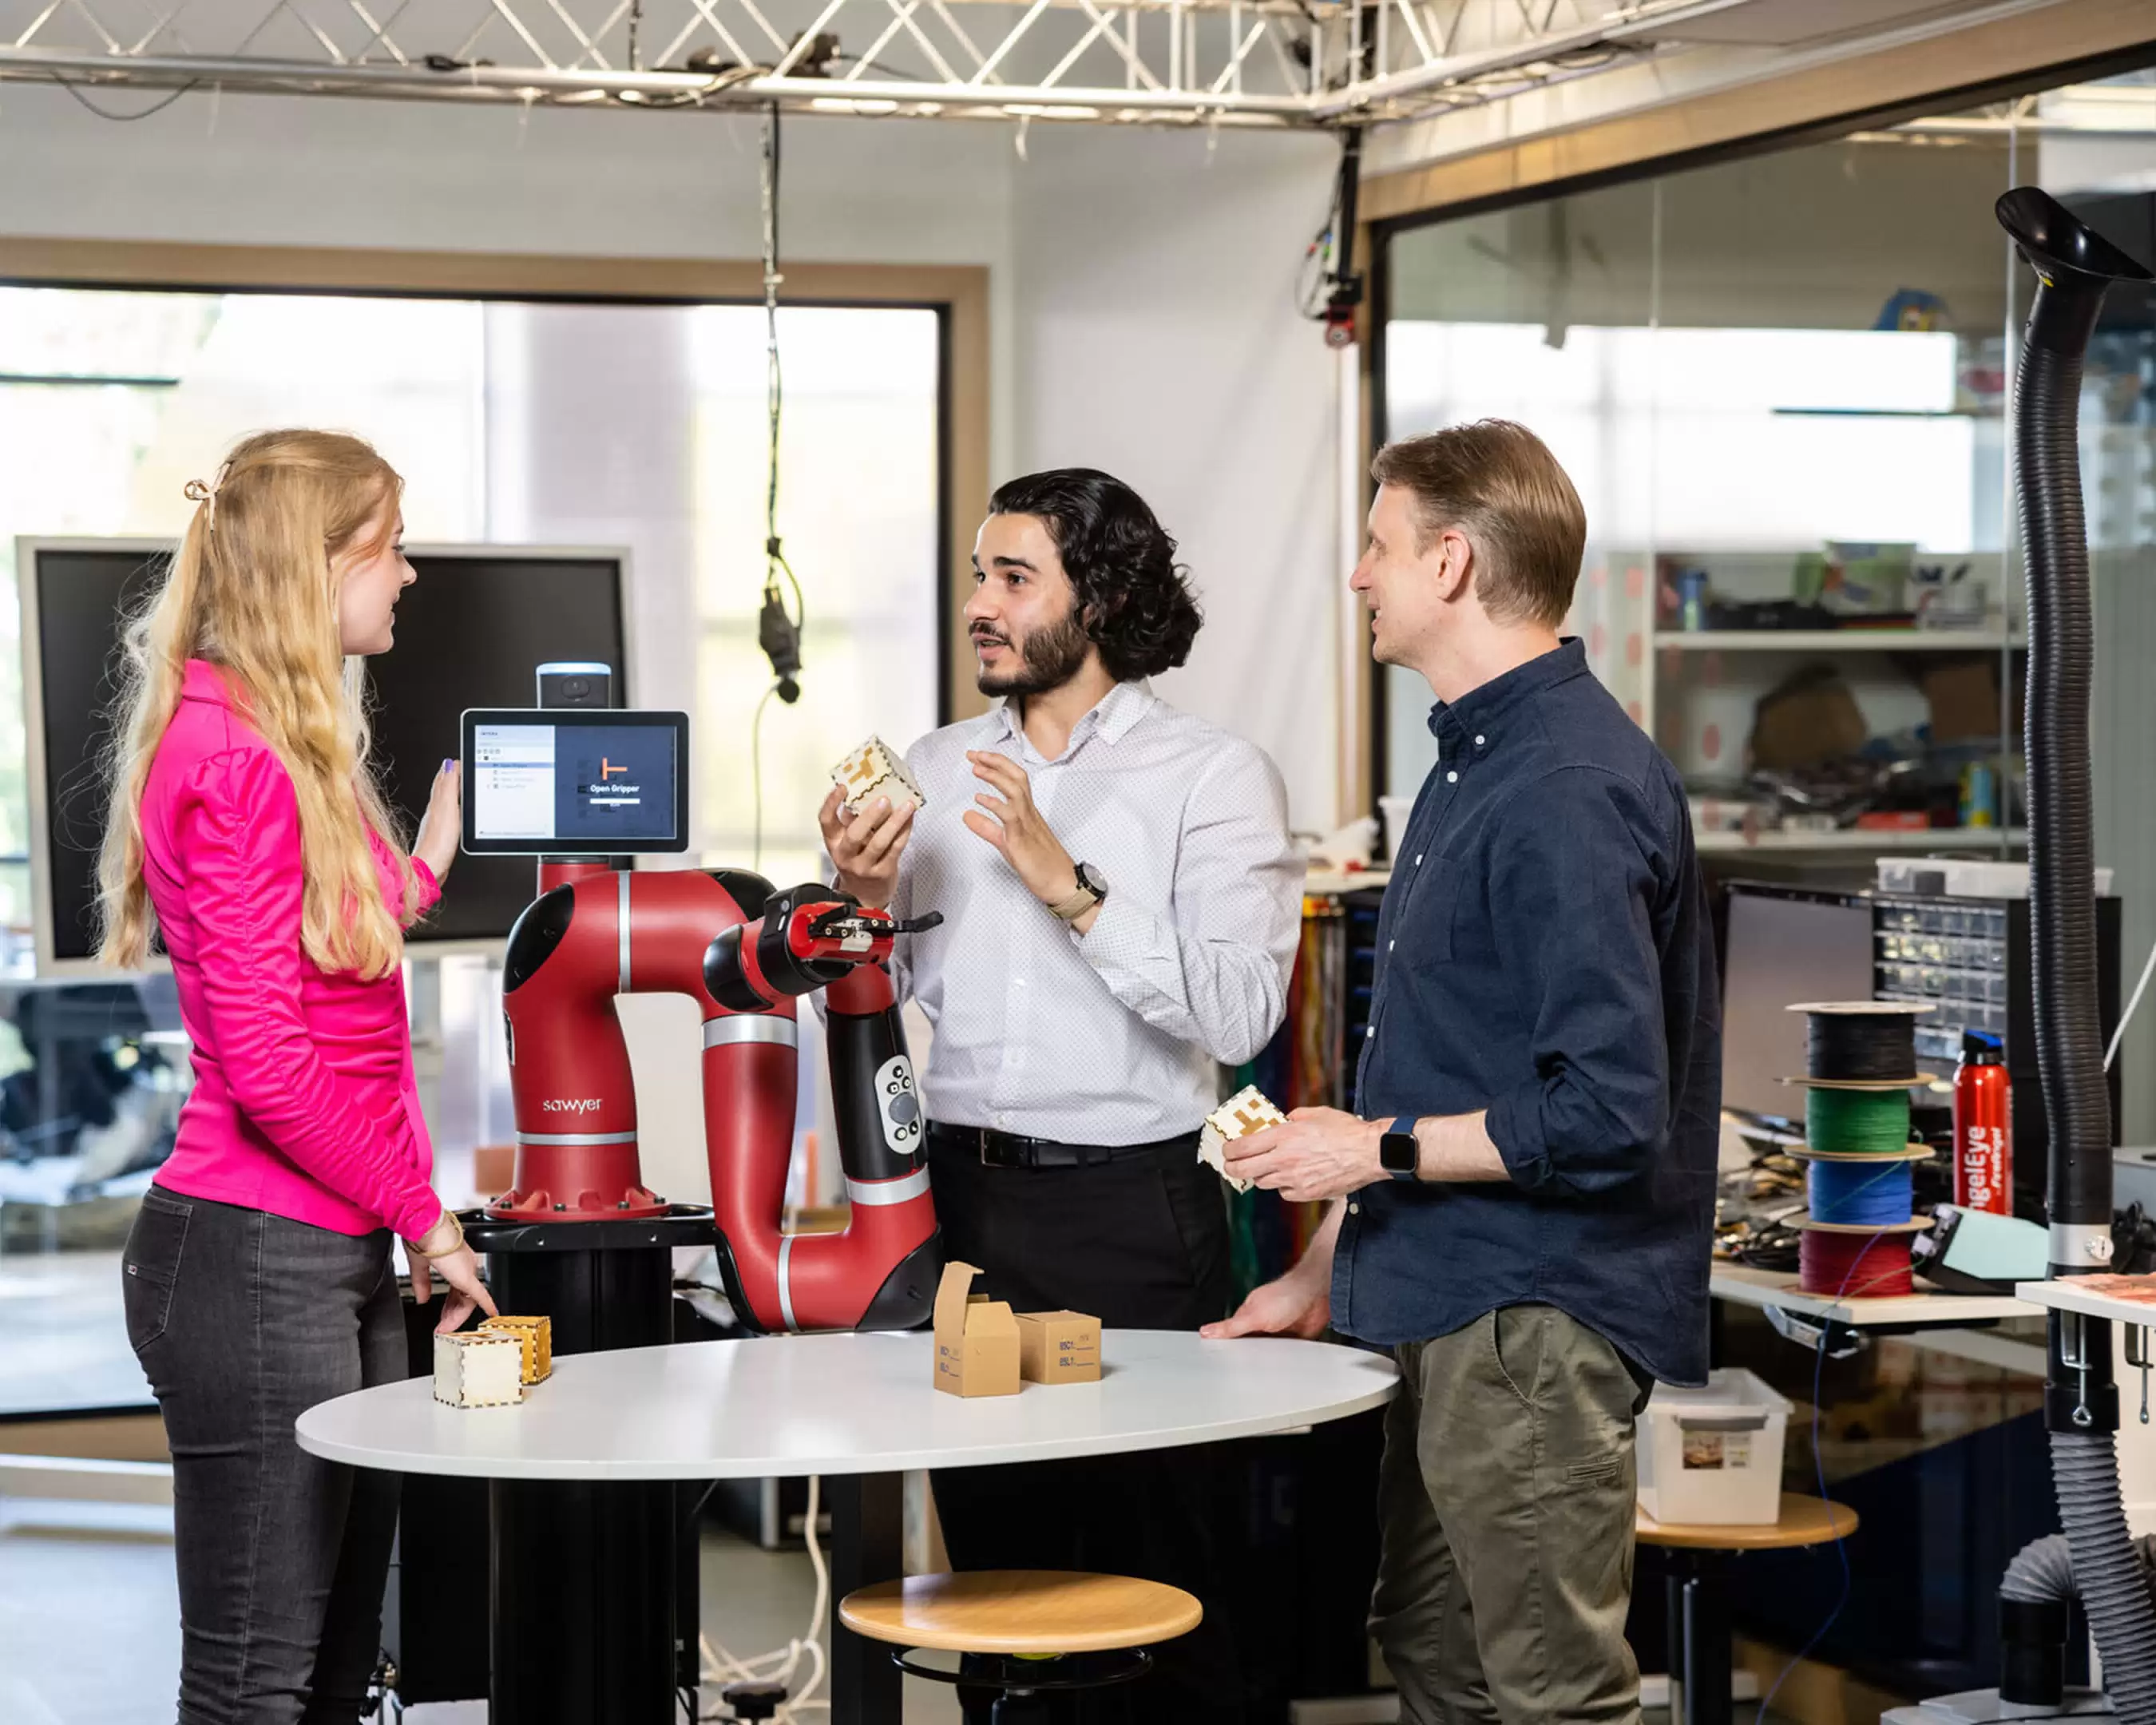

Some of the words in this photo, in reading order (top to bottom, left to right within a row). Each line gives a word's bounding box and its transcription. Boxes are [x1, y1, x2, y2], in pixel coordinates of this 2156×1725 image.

[590, 784, 610, 794] Open
[611, 784, 640, 794] Gripper
[543, 1098, 602, 1116] sawyer
[1964, 1125, 1991, 1211] ngelEye
